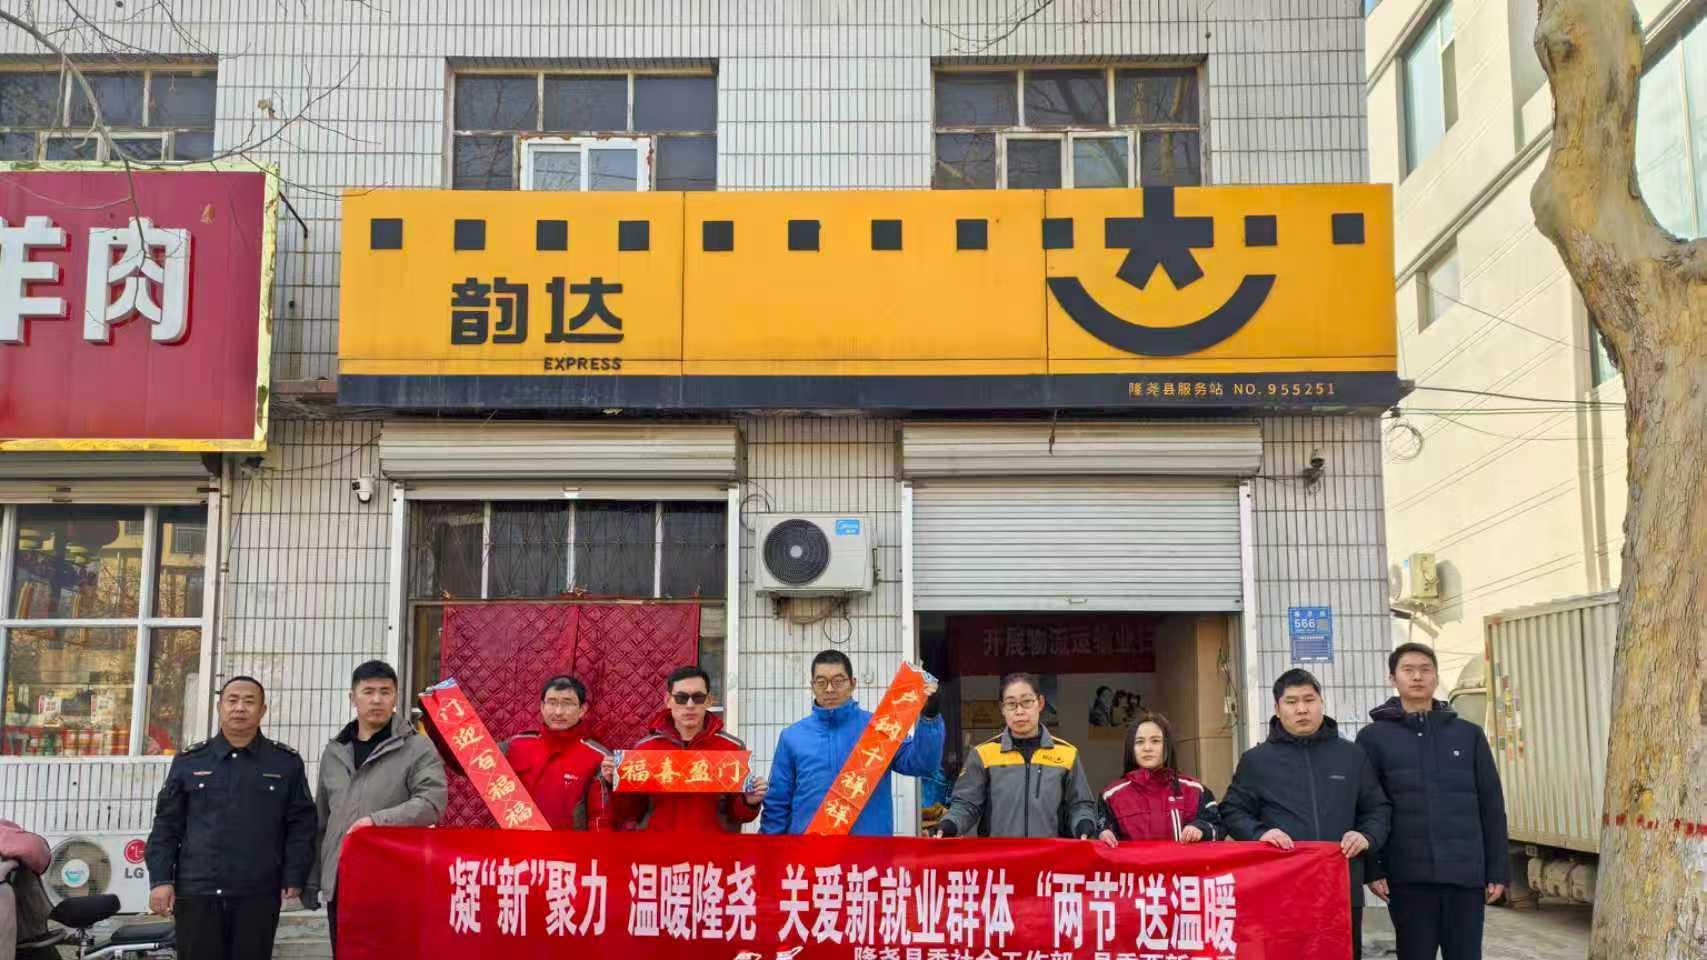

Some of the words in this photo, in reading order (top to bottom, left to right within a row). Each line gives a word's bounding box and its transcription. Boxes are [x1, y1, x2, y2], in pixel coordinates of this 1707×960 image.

[451, 276, 624, 345] 韵达
[544, 357, 623, 371] EXPRESS
[1128, 382, 1224, 397] 隆尧县服务站
[438, 698, 534, 827] 门迎百福福
[620, 755, 741, 784] 福喜盈门
[124, 867, 145, 879] LG
[628, 861, 757, 942] 温暖隆尧
[777, 864, 1014, 948] 关爱新就业群体
